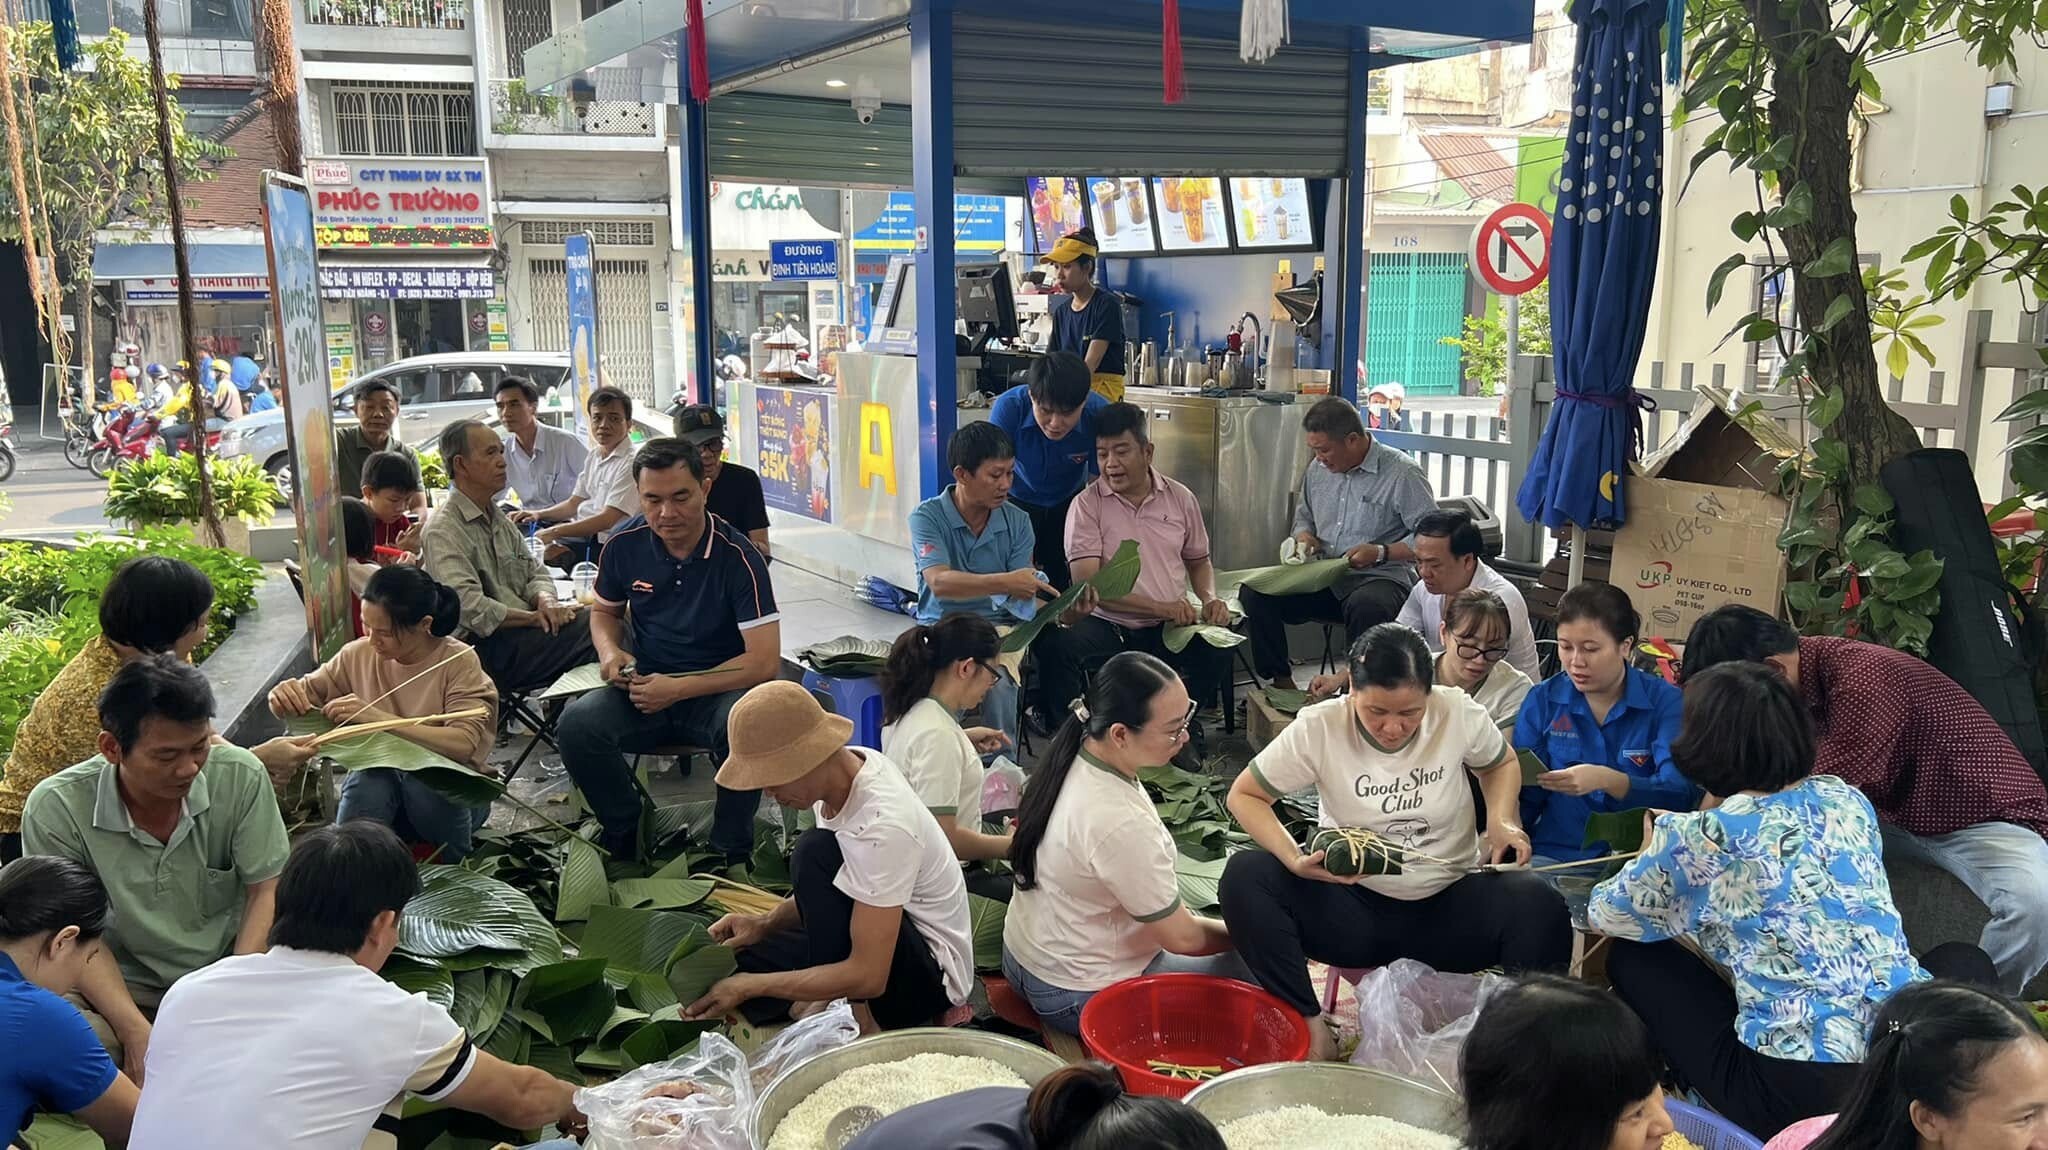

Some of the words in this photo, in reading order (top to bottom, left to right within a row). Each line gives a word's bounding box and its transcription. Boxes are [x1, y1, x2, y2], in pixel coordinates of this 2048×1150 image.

[359, 169, 385, 181] CTY
[424, 170, 441, 182] DV
[445, 170, 462, 182] SX
[464, 170, 482, 182] TM
[317, 186, 380, 211] PHÚC
[388, 186, 479, 212] TRƯỜNG
[784, 245, 823, 257] ĐƯỜNG
[1394, 236, 1418, 247] 168
[387, 271, 398, 287] PP
[402, 271, 423, 287] DECAL
[773, 263, 791, 277] ĐINH
[793, 260, 811, 276] TIÊN
[811, 259, 837, 276] HOÀNG
[295, 325, 319, 386] 29K
[859, 401, 897, 496] A
[760, 450, 790, 482] 35K
[1640, 569, 1671, 584] UKP
[1676, 577, 1689, 586] UY
[1690, 579, 1711, 590] KIET
[1734, 587, 1752, 597] LTD
[1677, 590, 1689, 598] PET
[1691, 592, 1705, 601] CUP
[1355, 774, 1400, 797] Good
[1402, 765, 1444, 792] Shot
[1381, 790, 1423, 814] Club
